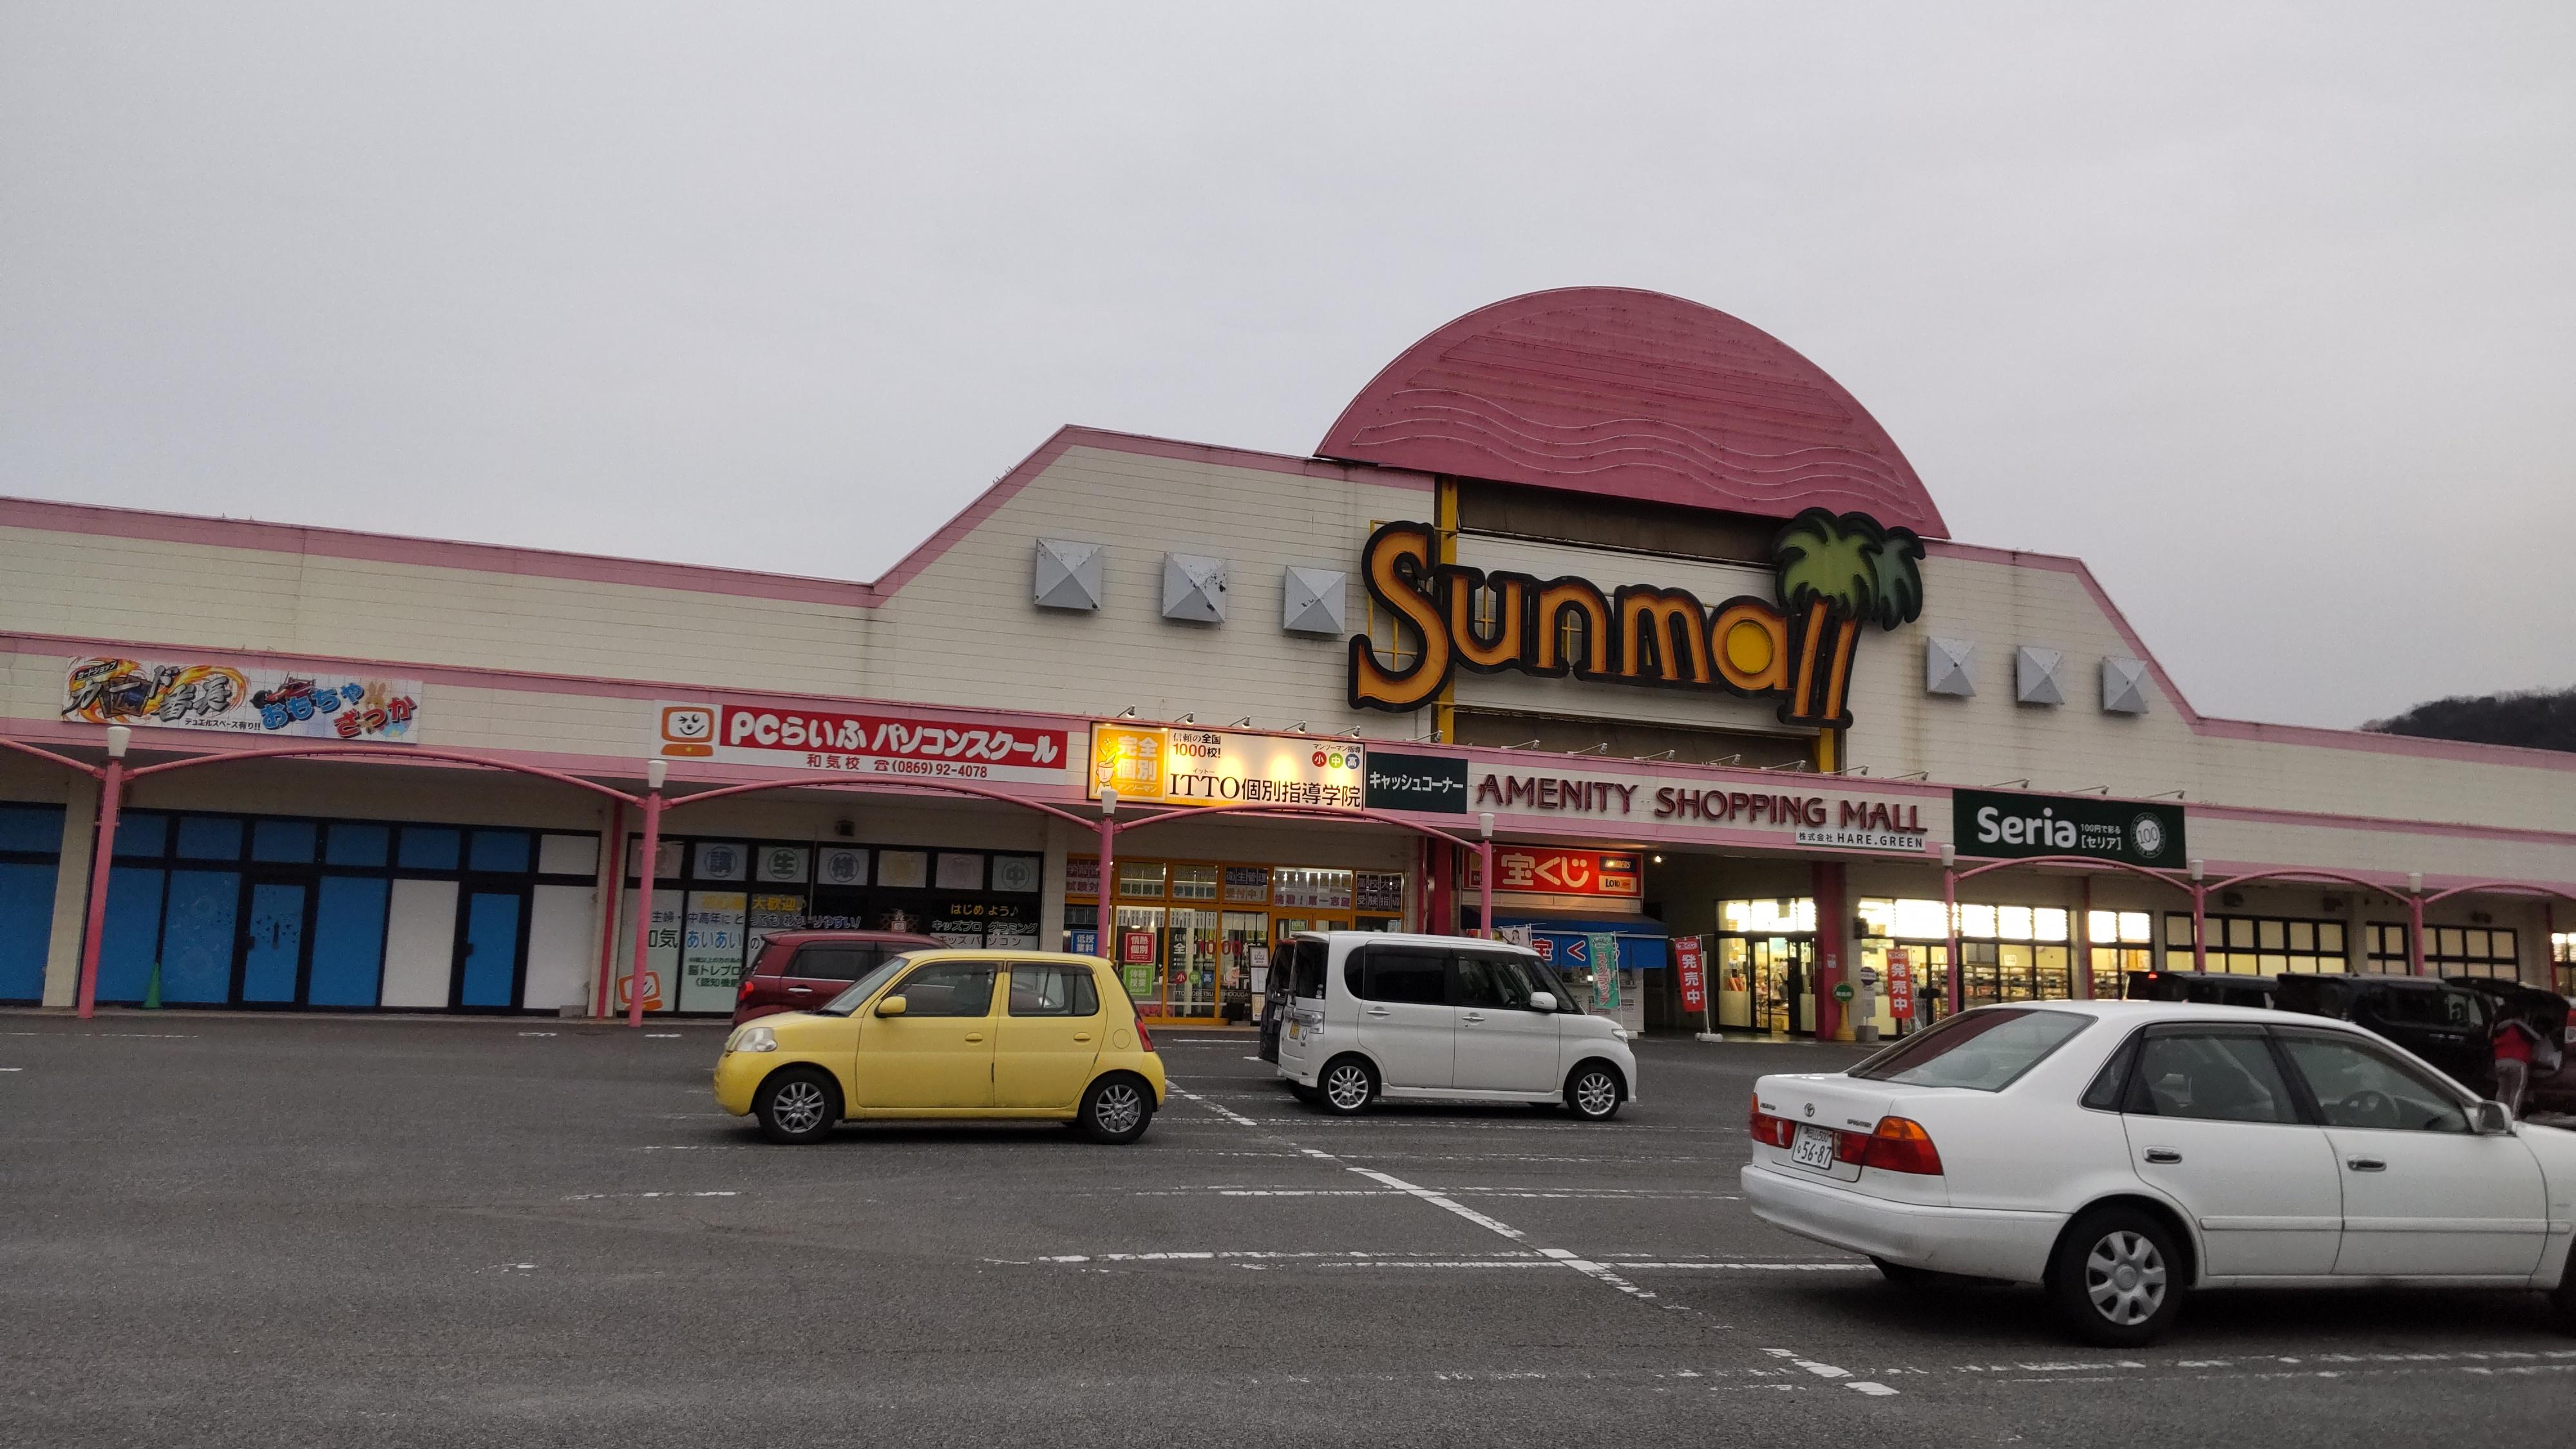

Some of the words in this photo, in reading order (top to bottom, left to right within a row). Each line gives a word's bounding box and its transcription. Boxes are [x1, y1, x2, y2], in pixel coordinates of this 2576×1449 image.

[1348, 520, 1857, 728] Sunmall
[77, 661, 117, 680] カードショップ
[261, 683, 365, 730] おもちゃ
[730, 711, 867, 750] PCらいふ
[872, 723, 1058, 764] パソコンスクール
[1118, 735, 1159, 757] 完全
[1173, 733, 1221, 746] 信頼の全国
[1312, 743, 1361, 753] マンツーマン指導
[807, 753, 860, 772] 和気校
[1173, 743, 1221, 759] 1000校!
[1117, 759, 1157, 781] 個別
[1117, 784, 1157, 793] マンツーマン
[1368, 770, 1465, 794] キャッシュコーナー
[1476, 773, 1640, 815] AMENITY
[1654, 786, 1827, 828] SHOPPING
[1840, 799, 1928, 834] MALL
[1976, 806, 2078, 849] Seria
[1798, 831, 1833, 843] 株式会社
[1837, 832, 1924, 849] HARE.GREEN
[1501, 851, 1590, 889] 宝くじ
[1681, 954, 1700, 1005] 発売中
[1891, 963, 1908, 1012] 発売中
